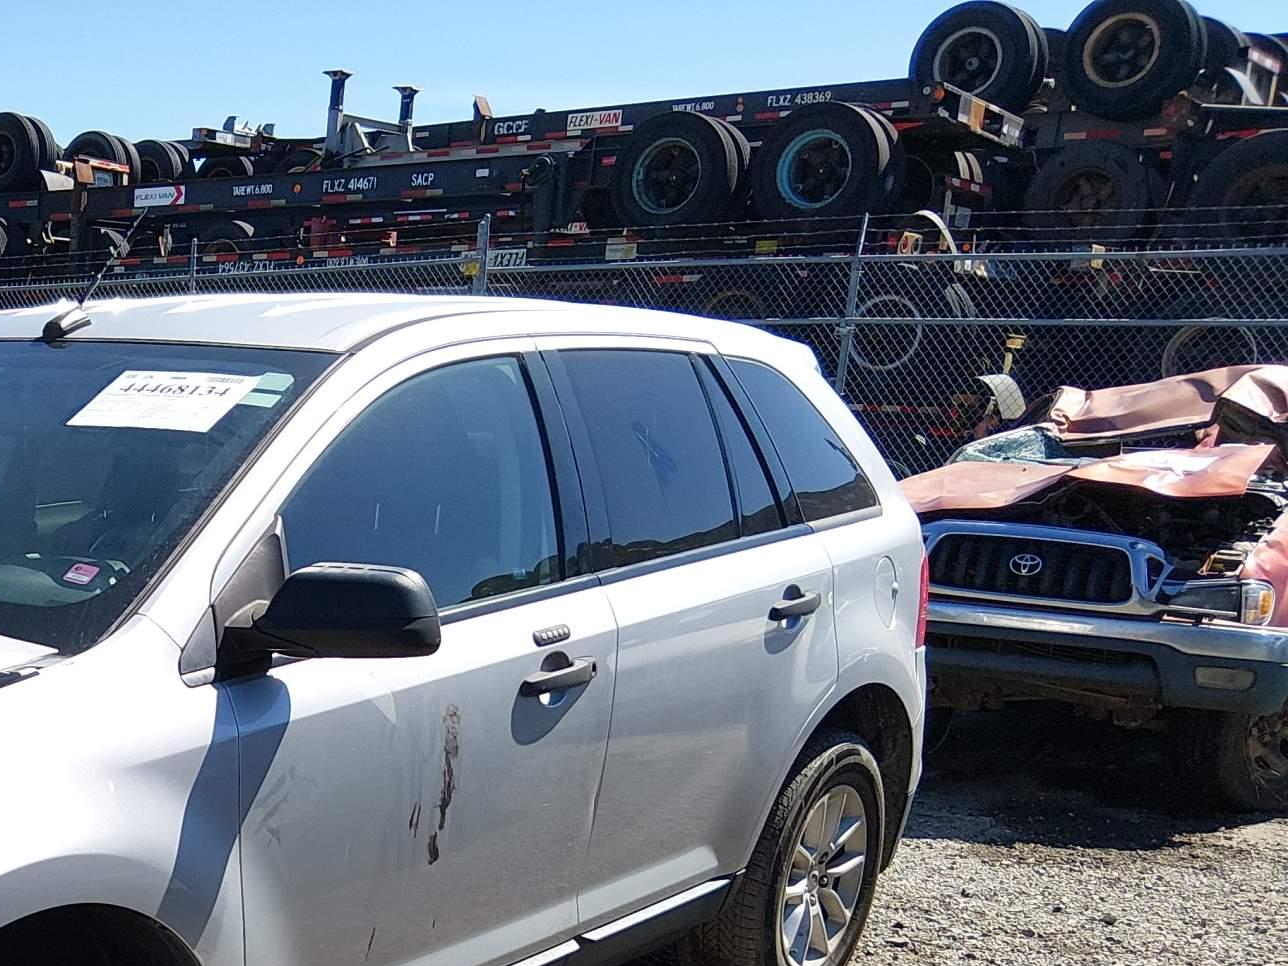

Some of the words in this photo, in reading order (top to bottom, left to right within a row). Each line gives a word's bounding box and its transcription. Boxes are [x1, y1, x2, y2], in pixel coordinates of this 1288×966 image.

[767, 94, 792, 107] FLXZ
[794, 91, 832, 105] 438369
[567, 111, 621, 128] FLEXI-VAN
[323, 179, 345, 193] FLXZ
[347, 176, 378, 192] 414671
[411, 172, 435, 187] SACP
[255, 184, 273, 194] 6.800
[119, 382, 231, 398] 44468134
